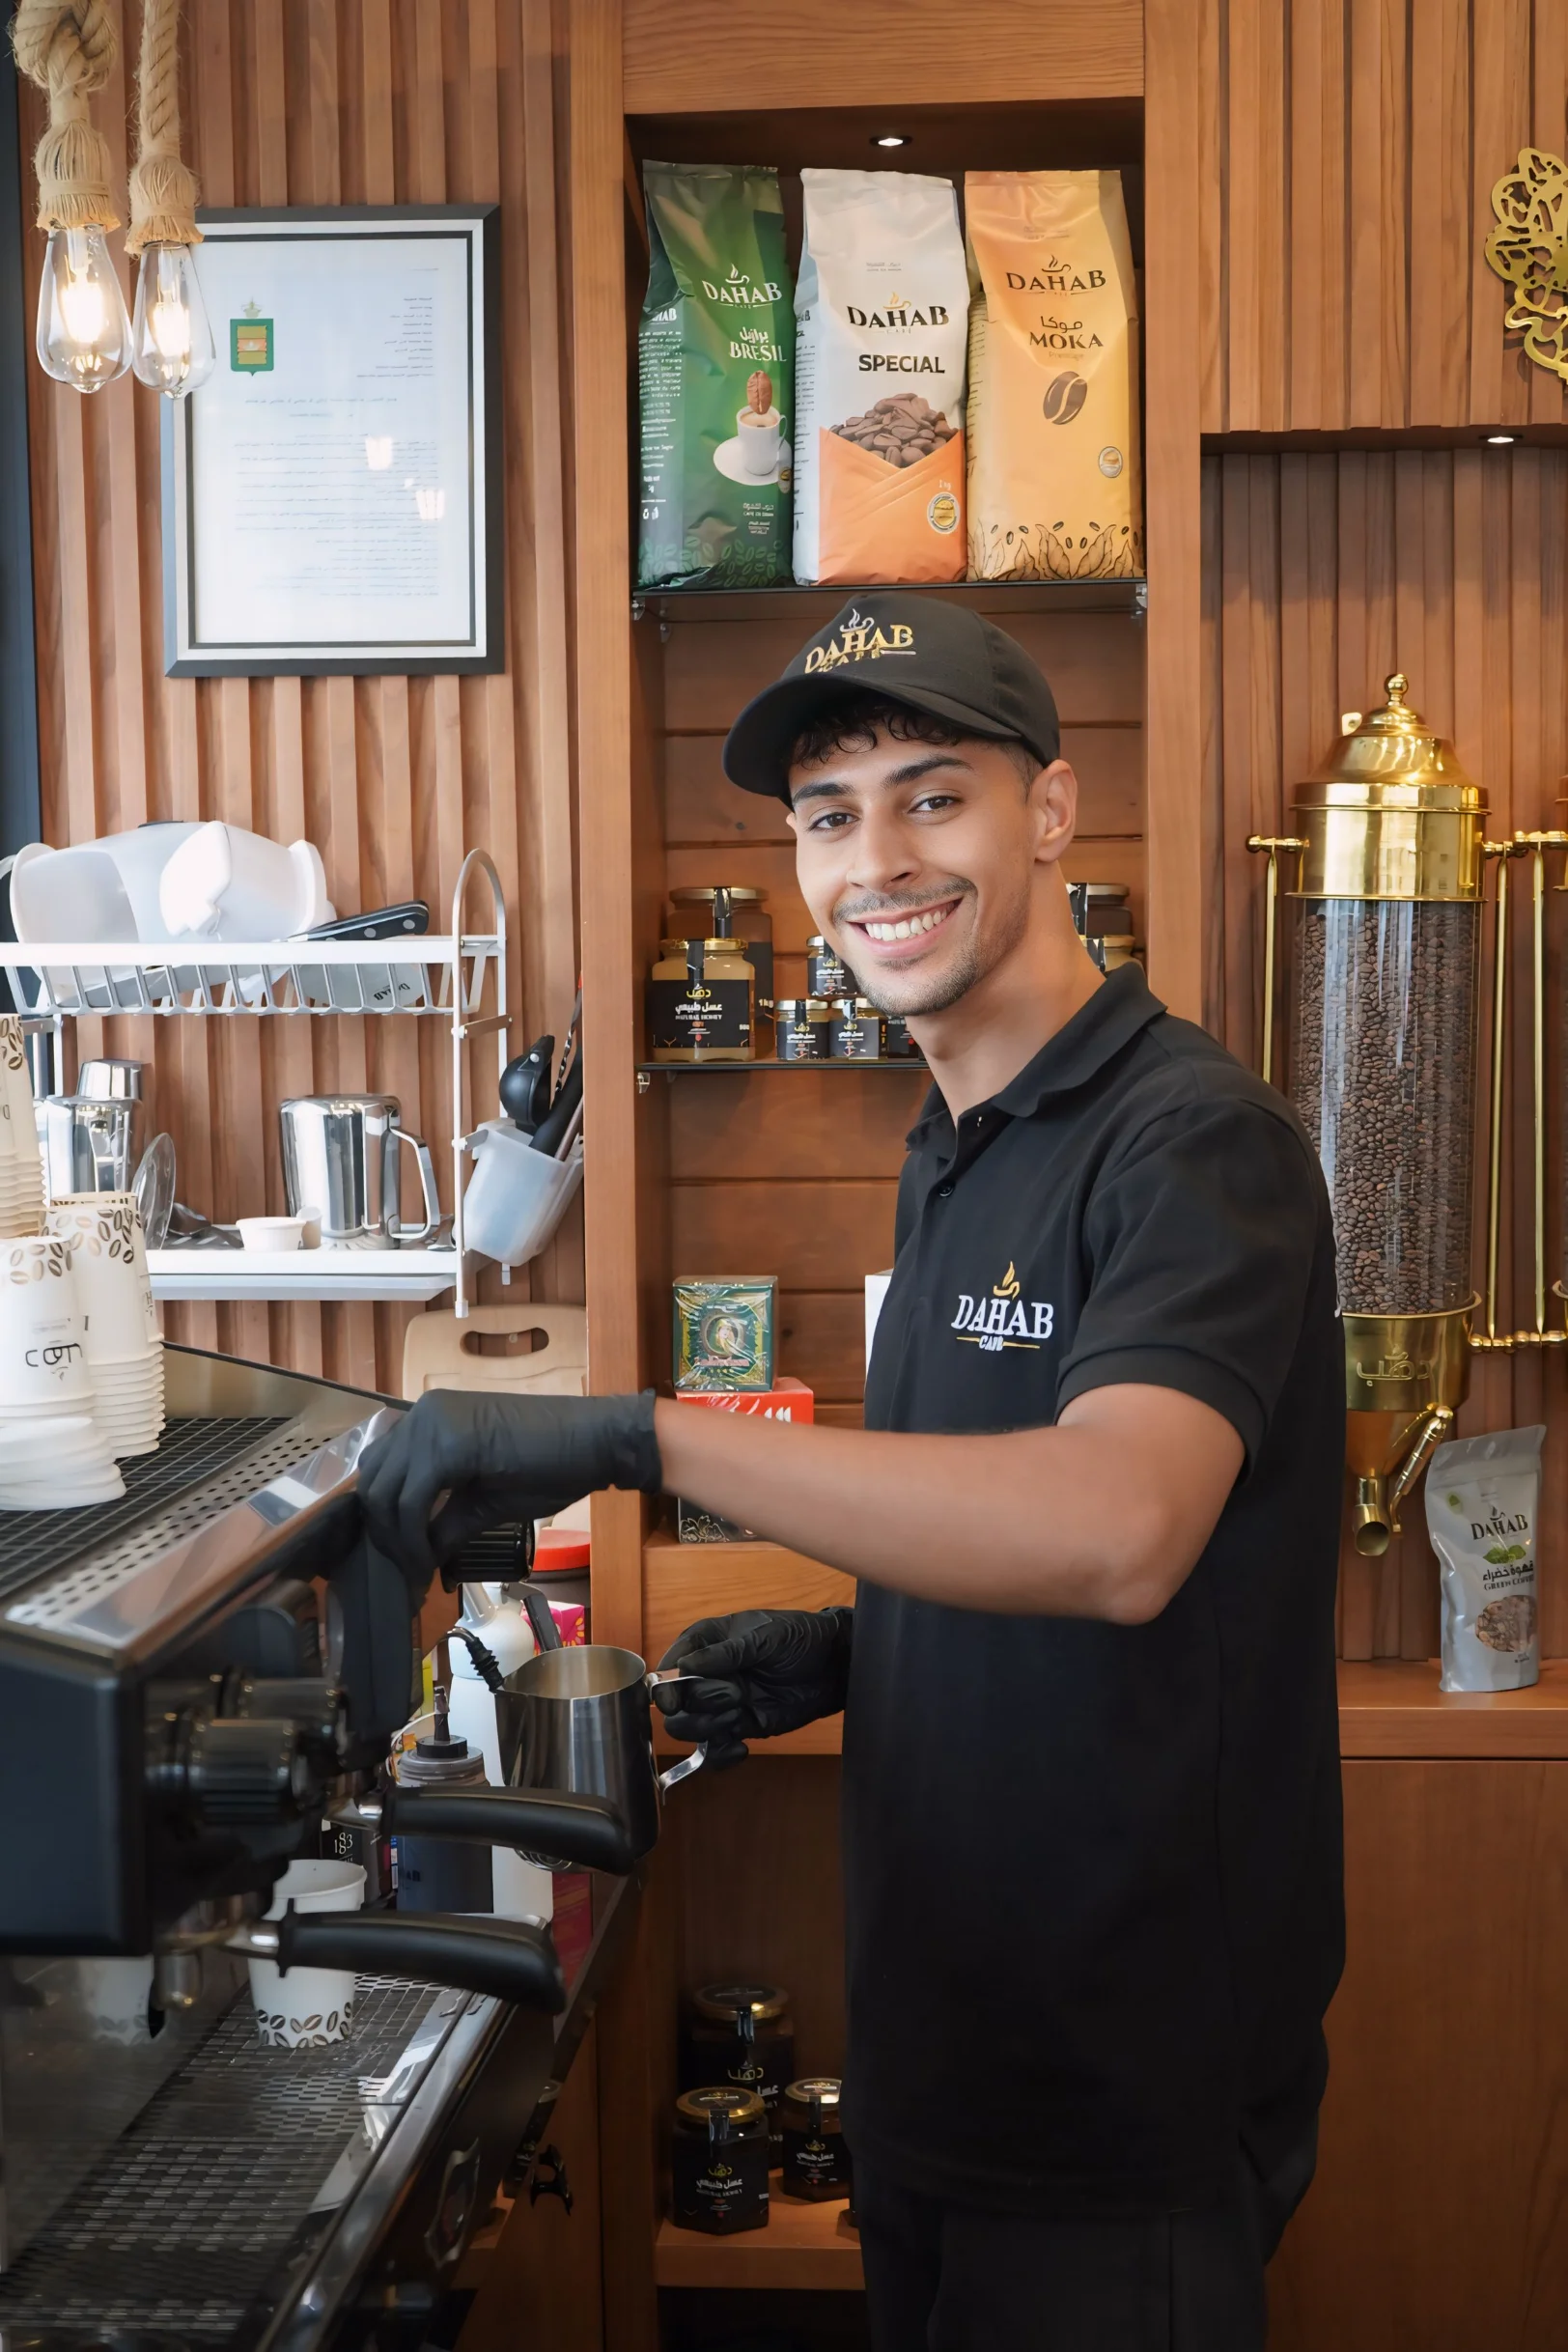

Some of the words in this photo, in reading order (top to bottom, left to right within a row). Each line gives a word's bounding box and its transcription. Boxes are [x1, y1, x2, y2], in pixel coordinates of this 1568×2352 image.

[1005, 269, 1106, 291] DAHAB
[702, 280, 782, 304] DAHAB
[847, 305, 949, 328] DAHAB
[1040, 315, 1083, 333] موكا
[1029, 331, 1105, 349] MOKA
[730, 341, 788, 362] BRESIL
[858, 353, 946, 374] SPECIAL
[804, 624, 914, 674] DAHAB
[675, 1001, 702, 1015] طبيعي
[702, 1001, 723, 1013] عسل
[950, 1294, 1054, 1340] DAHAB
[1470, 1513, 1528, 1541] DAHAB
[1482, 1566, 1510, 1582] خضراء
[722, 2177, 743, 2189] عسل
